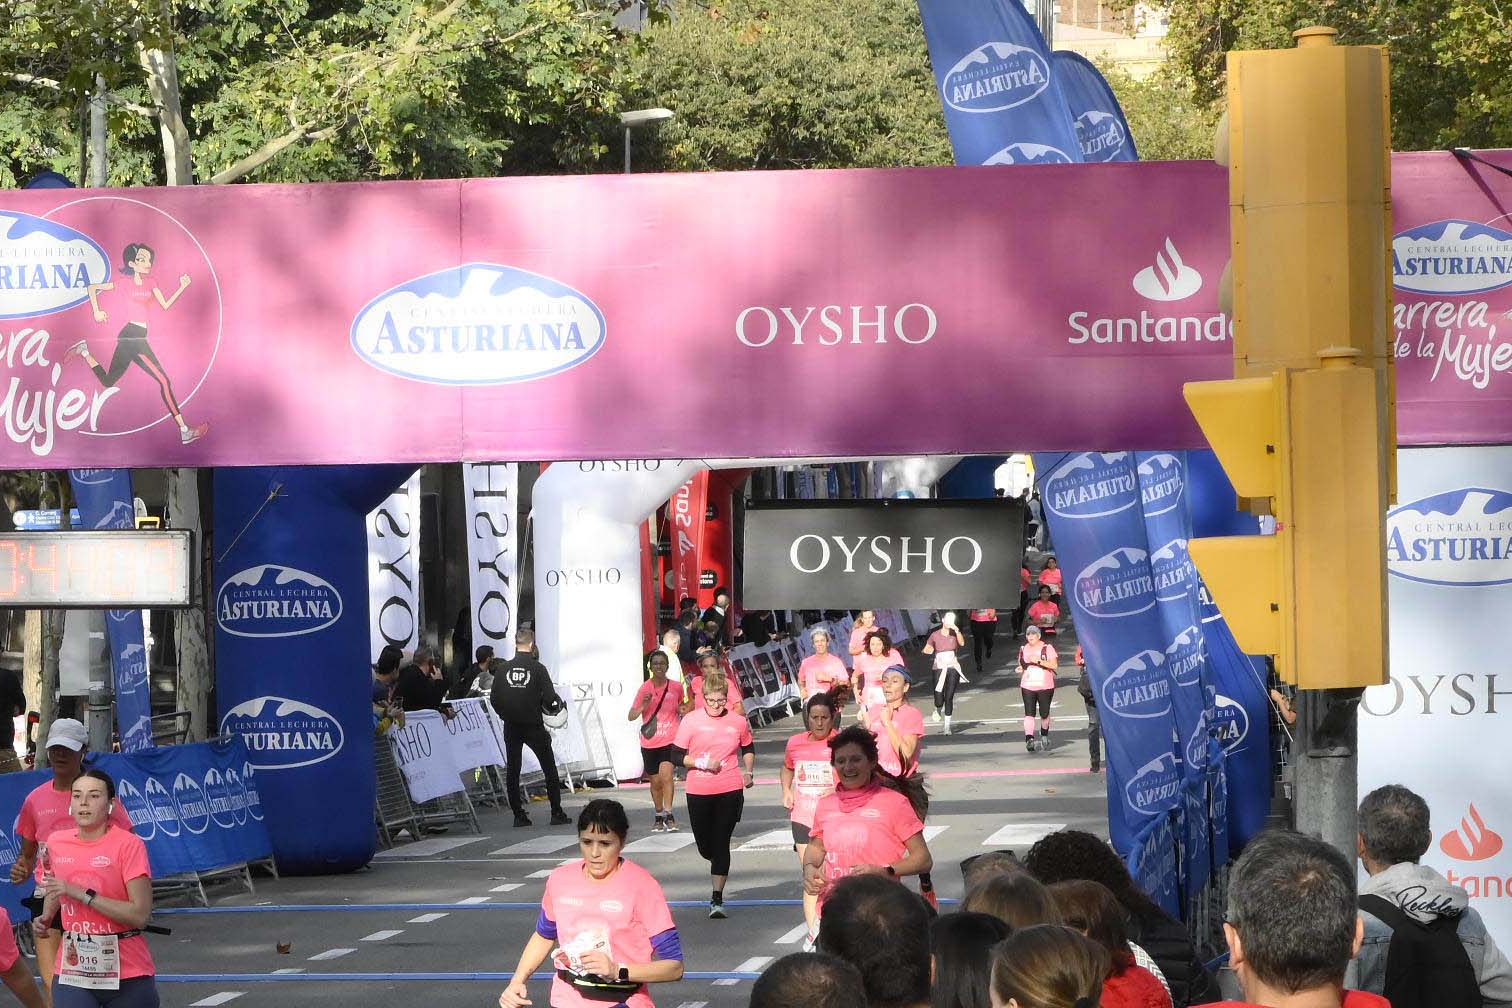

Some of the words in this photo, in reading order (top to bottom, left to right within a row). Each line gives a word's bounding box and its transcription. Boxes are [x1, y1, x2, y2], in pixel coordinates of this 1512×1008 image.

[1407, 246, 1459, 254] CENTRAL
[1464, 245, 1512, 253] LECHER
[734, 303, 937, 347] OYSHO
[1068, 310, 1233, 345] Santand
[1394, 301, 1489, 330] arrera
[371, 310, 585, 355] ASTURIANA
[1417, 329, 1435, 358] la
[1430, 324, 1512, 390] Muje
[1414, 523, 1482, 532] CENTRAL
[472, 462, 511, 641] OYSH
[789, 534, 983, 575] OYSHO
[545, 567, 622, 587] OYSHO
[220, 594, 334, 622] ASTURIANA
[233, 590, 275, 598] CENTRAL
[280, 589, 328, 598] LECHERA
[1361, 673, 1512, 716] OYSH
[280, 721, 329, 729] LECHERA
